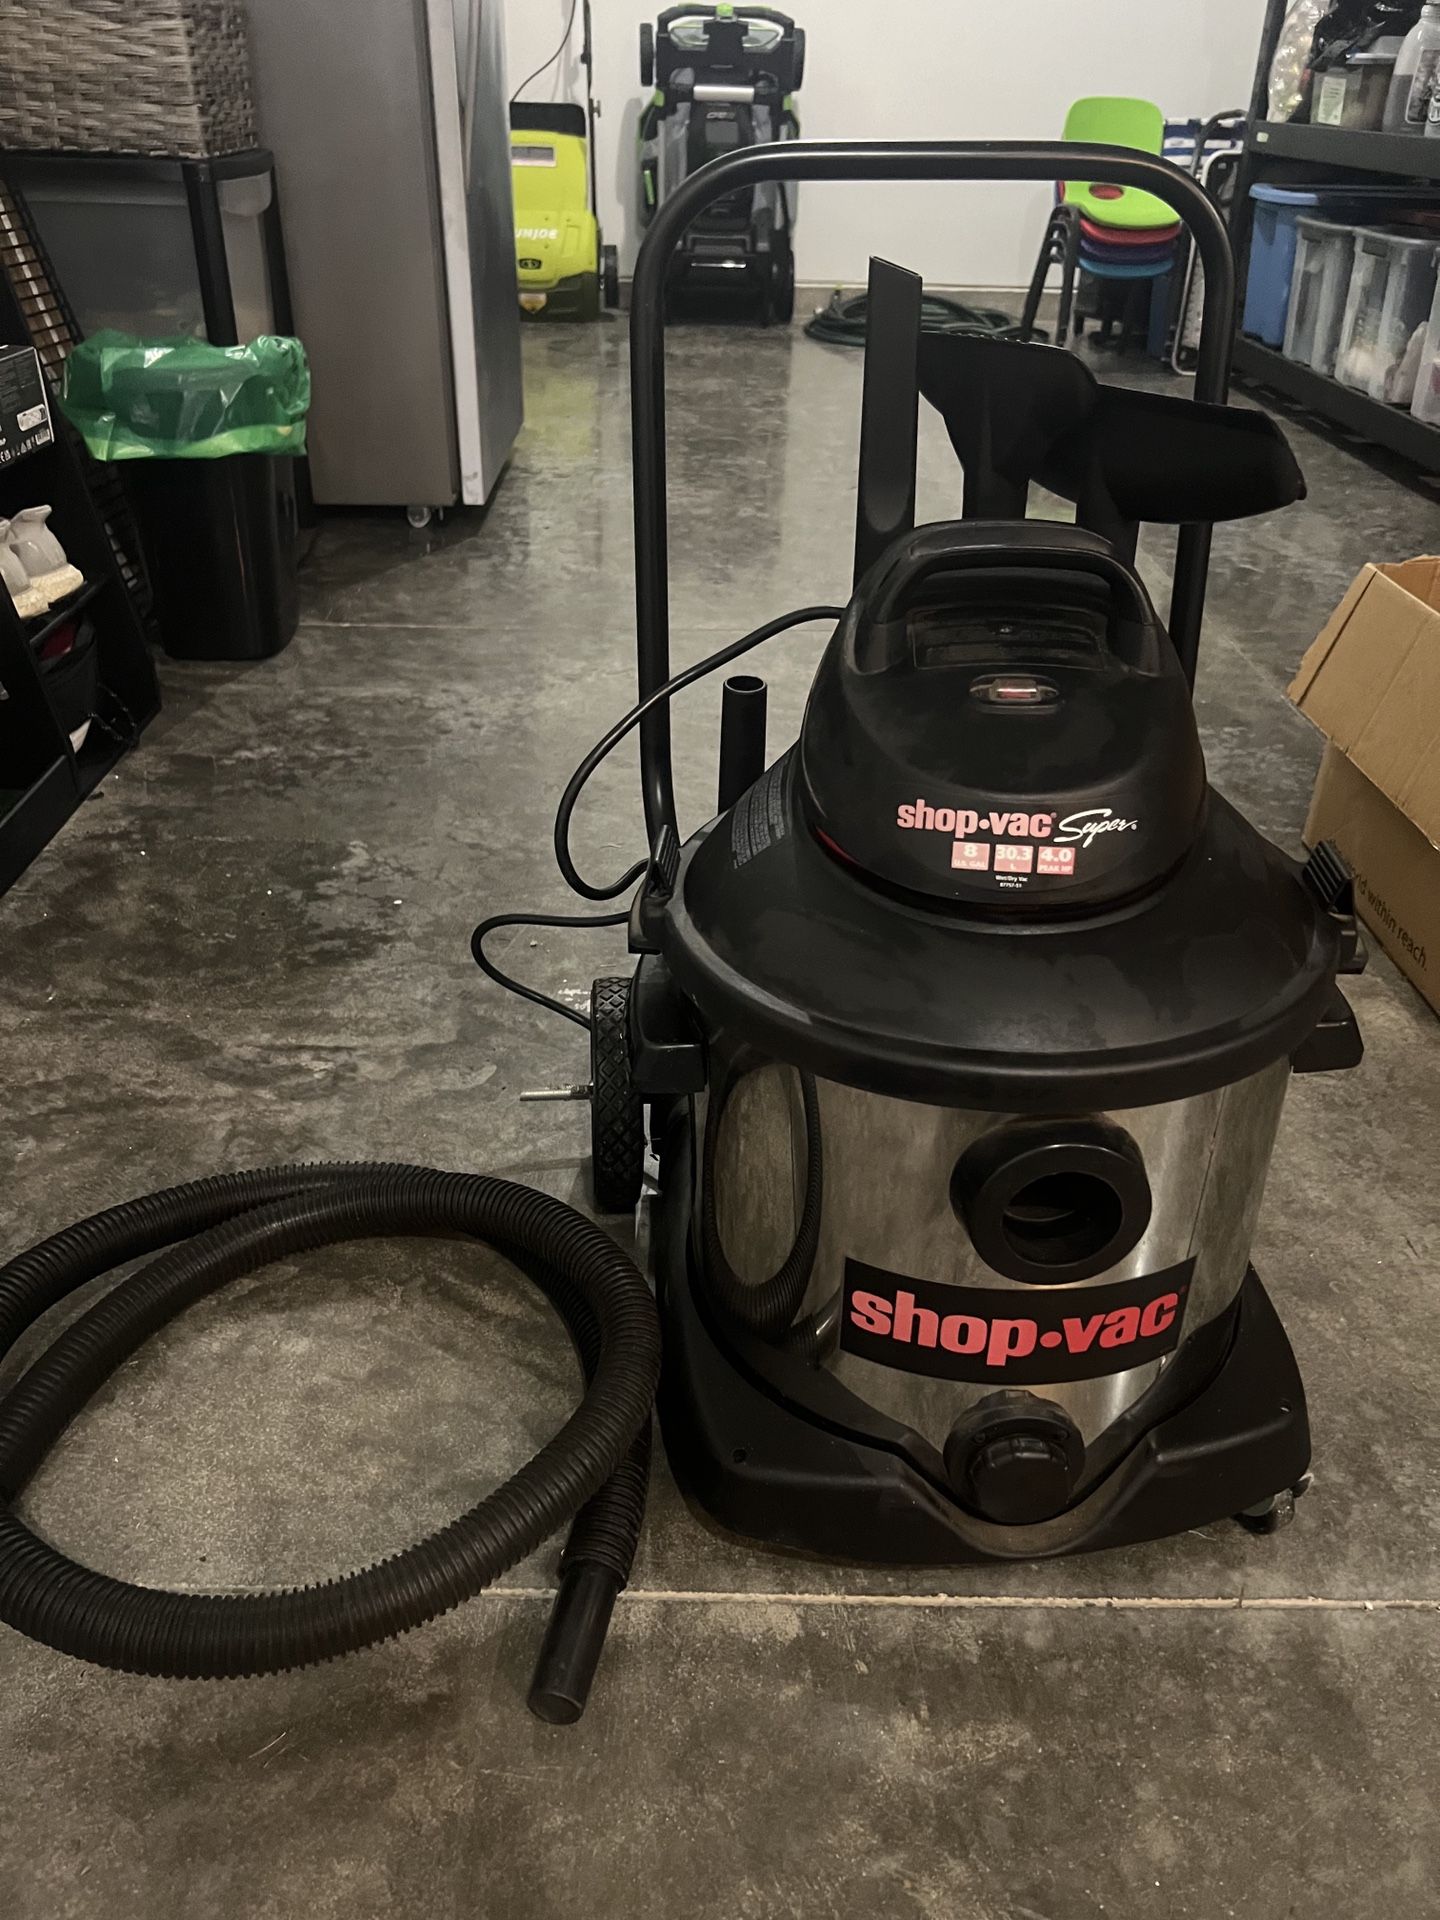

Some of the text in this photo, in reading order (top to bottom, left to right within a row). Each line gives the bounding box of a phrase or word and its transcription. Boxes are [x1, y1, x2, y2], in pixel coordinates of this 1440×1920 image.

[514, 228, 559, 240] UNJOE
[1053, 808, 1139, 849] Super
[963, 843, 978, 858] 8
[996, 845, 1032, 861] 30.3
[1040, 847, 1073, 863] 4.0
[1367, 890, 1397, 933] within
